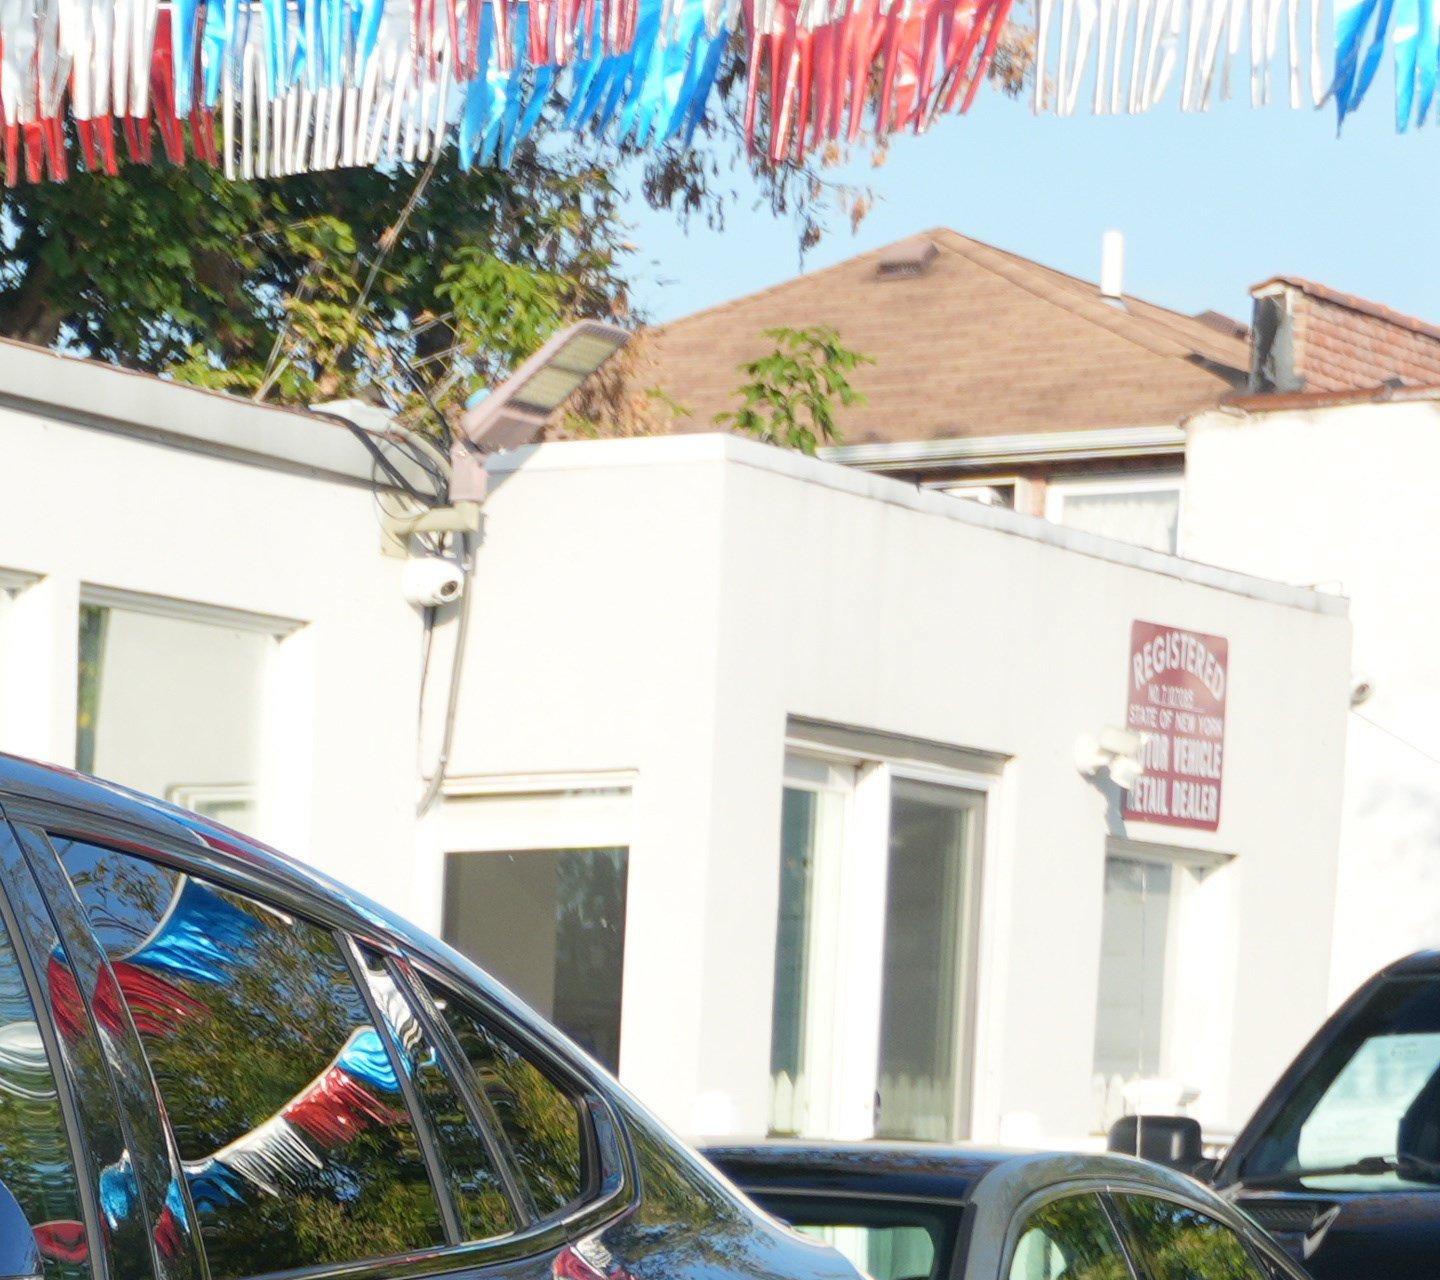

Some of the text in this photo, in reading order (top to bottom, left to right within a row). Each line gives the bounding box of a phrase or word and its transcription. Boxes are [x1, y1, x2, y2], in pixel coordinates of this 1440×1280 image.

[1133, 632, 1226, 701] REGISTERED
[1129, 704, 1225, 738] STATE OF NEW YORK
[1173, 735, 1223, 780] VEHICLE
[1171, 780, 1220, 822] DEALER
